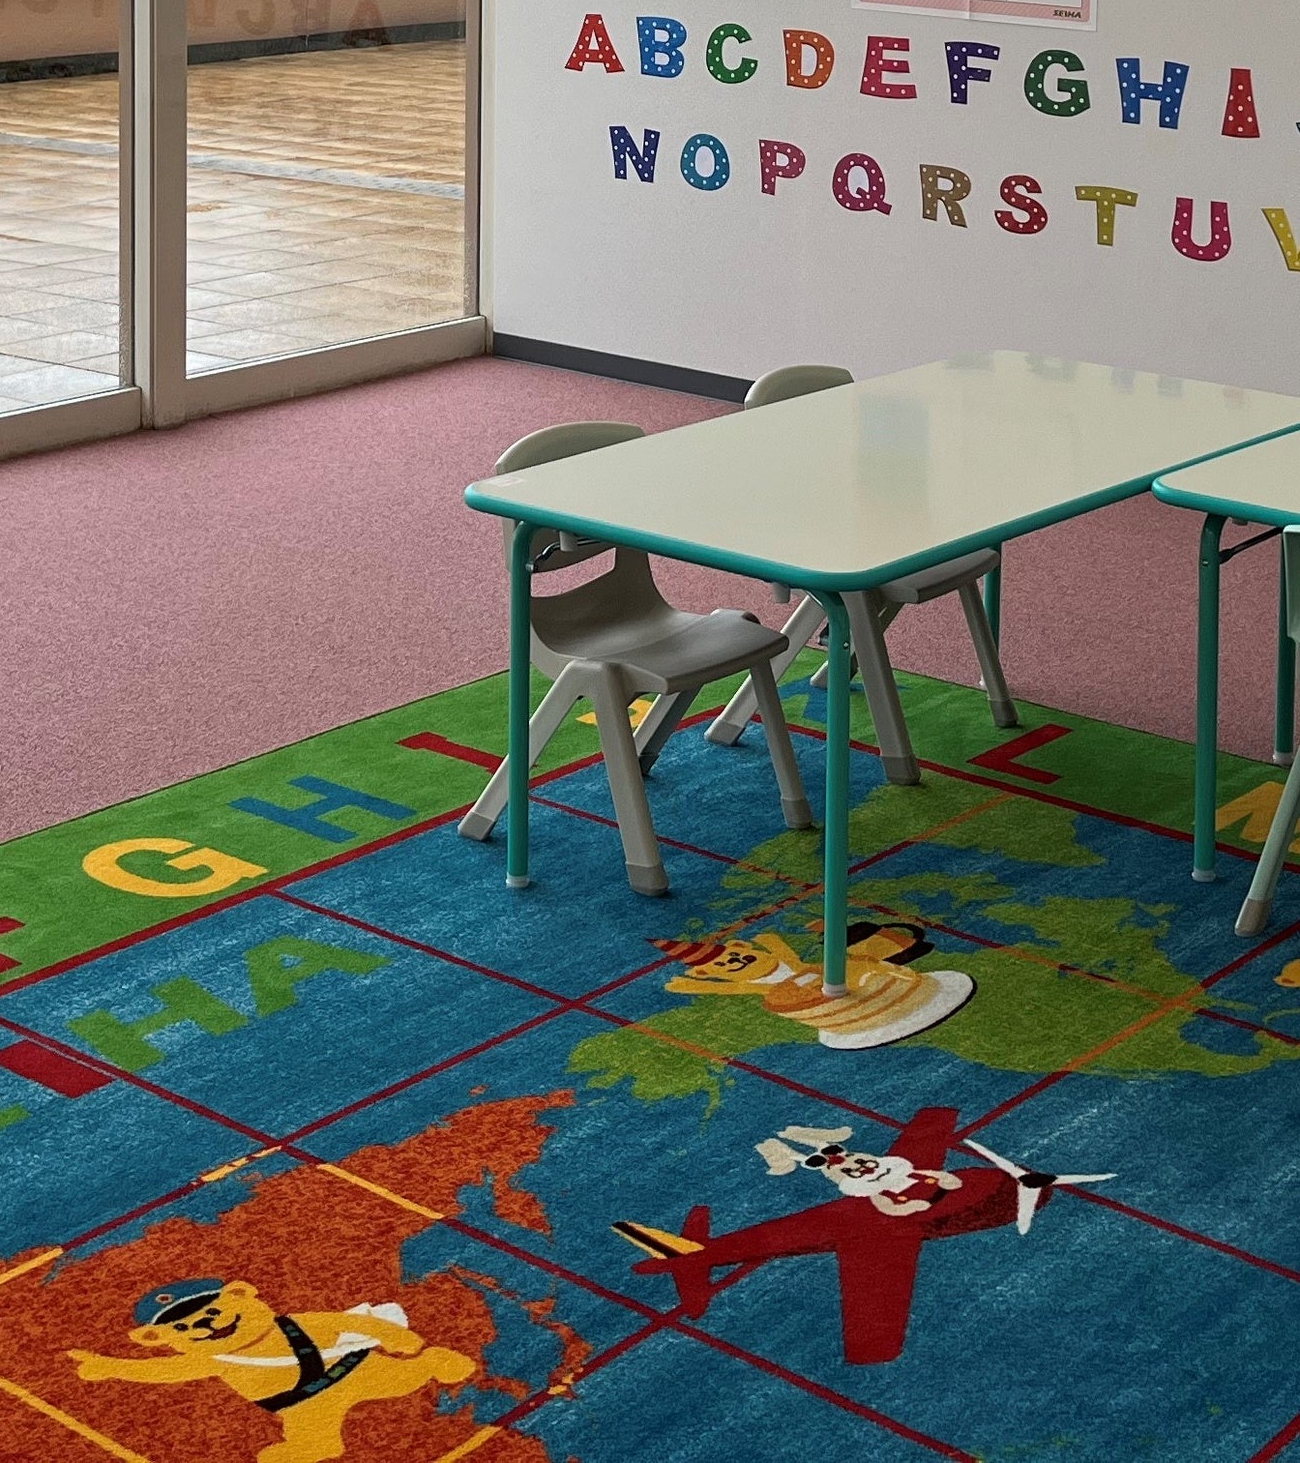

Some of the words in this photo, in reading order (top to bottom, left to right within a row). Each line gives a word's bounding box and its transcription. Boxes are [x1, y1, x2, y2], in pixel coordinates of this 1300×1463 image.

[1052, 9, 1082, 19] SEIHA
[967, 723, 1074, 784] L
[230, 774, 419, 844] H
[82, 837, 270, 897] G
